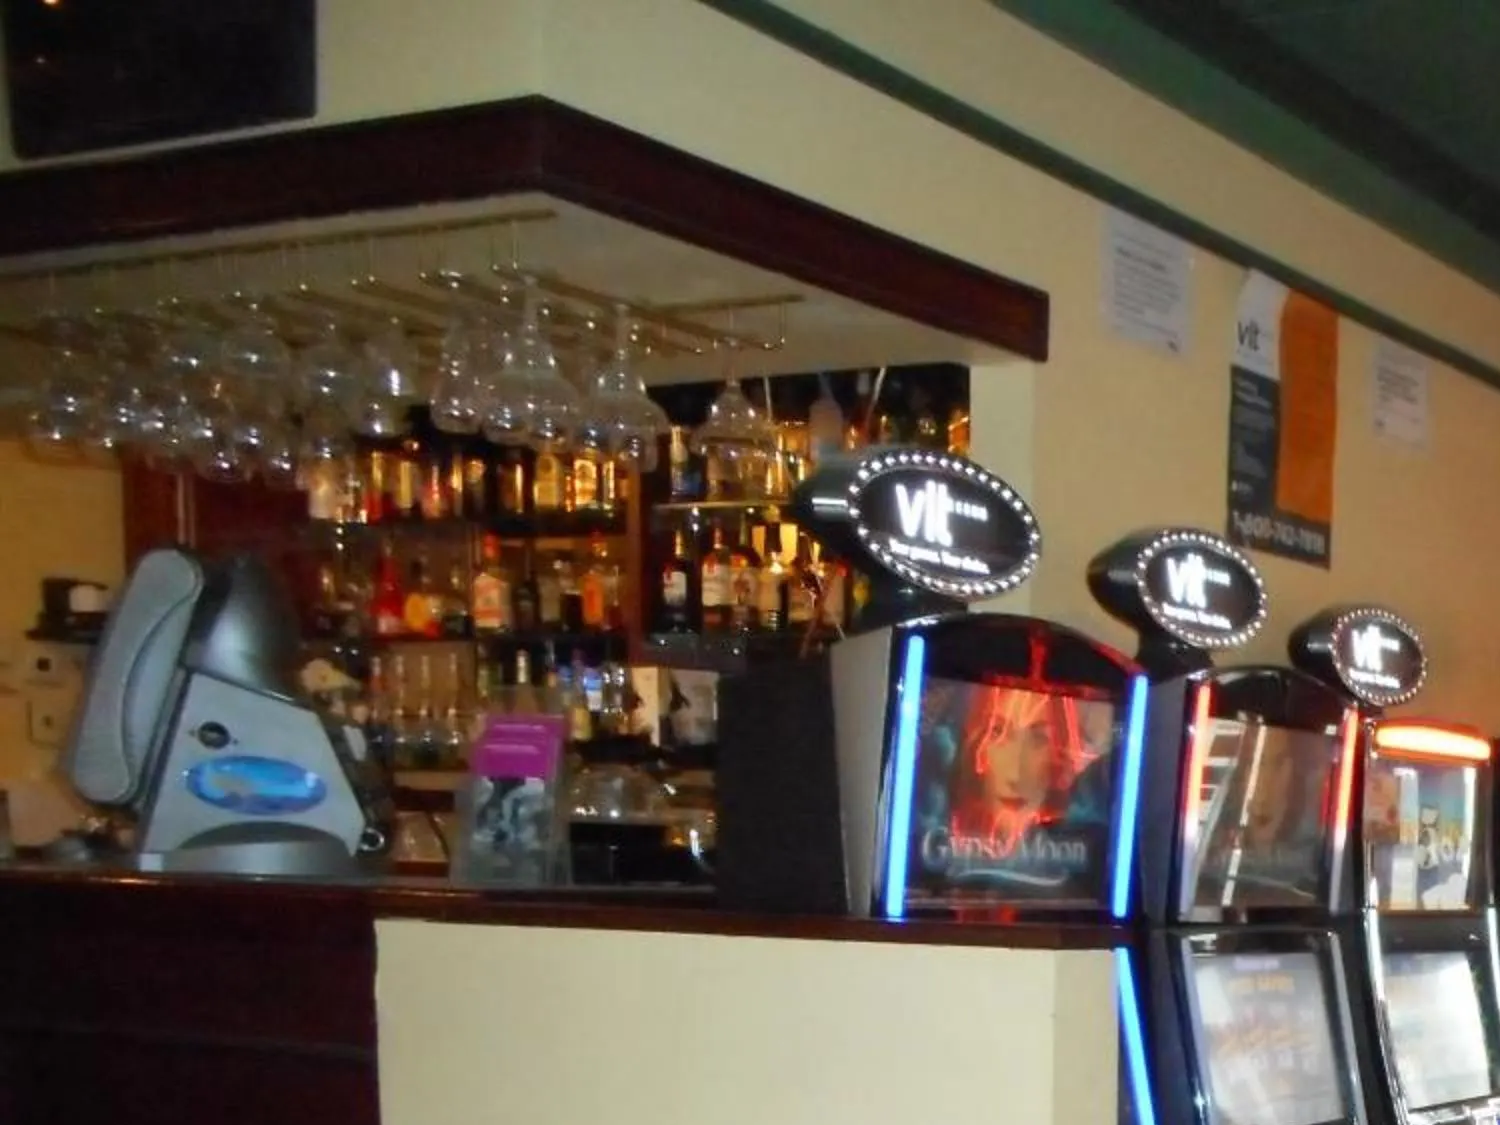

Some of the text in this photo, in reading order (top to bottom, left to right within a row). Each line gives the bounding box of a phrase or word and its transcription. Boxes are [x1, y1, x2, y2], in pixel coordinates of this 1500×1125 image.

[1237, 318, 1260, 351] vlt
[895, 480, 954, 546] vlt
[921, 827, 1088, 871] Gypsy Moon
